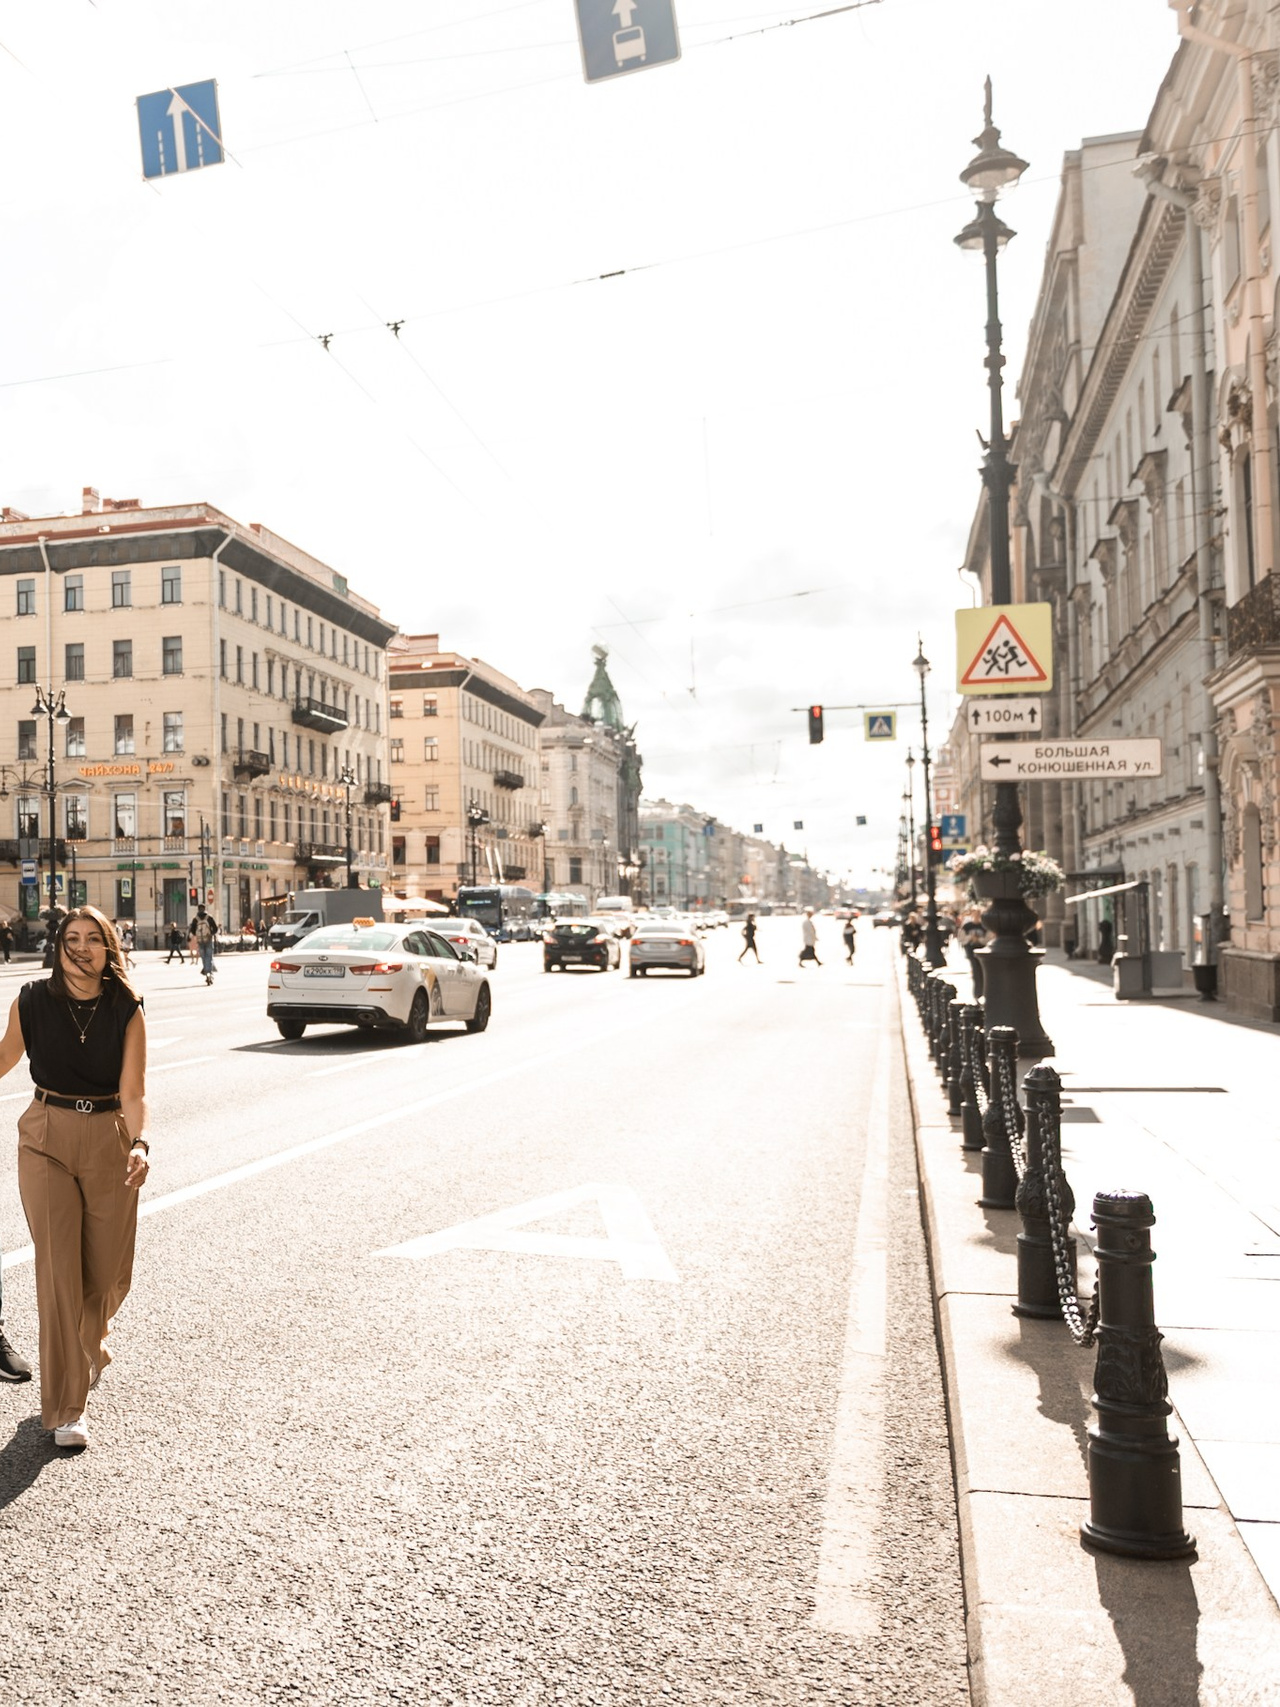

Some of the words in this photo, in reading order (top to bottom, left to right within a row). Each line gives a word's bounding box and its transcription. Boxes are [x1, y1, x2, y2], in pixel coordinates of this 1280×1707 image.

[1035, 746, 1110, 758] БОЛЬШАЯ
[79, 764, 140, 777] ЧАЙХОНА
[149, 762, 174, 774] 24/7
[1017, 761, 1127, 773] КОНЮШЕННАЯ
[1134, 761, 1154, 772] ул.
